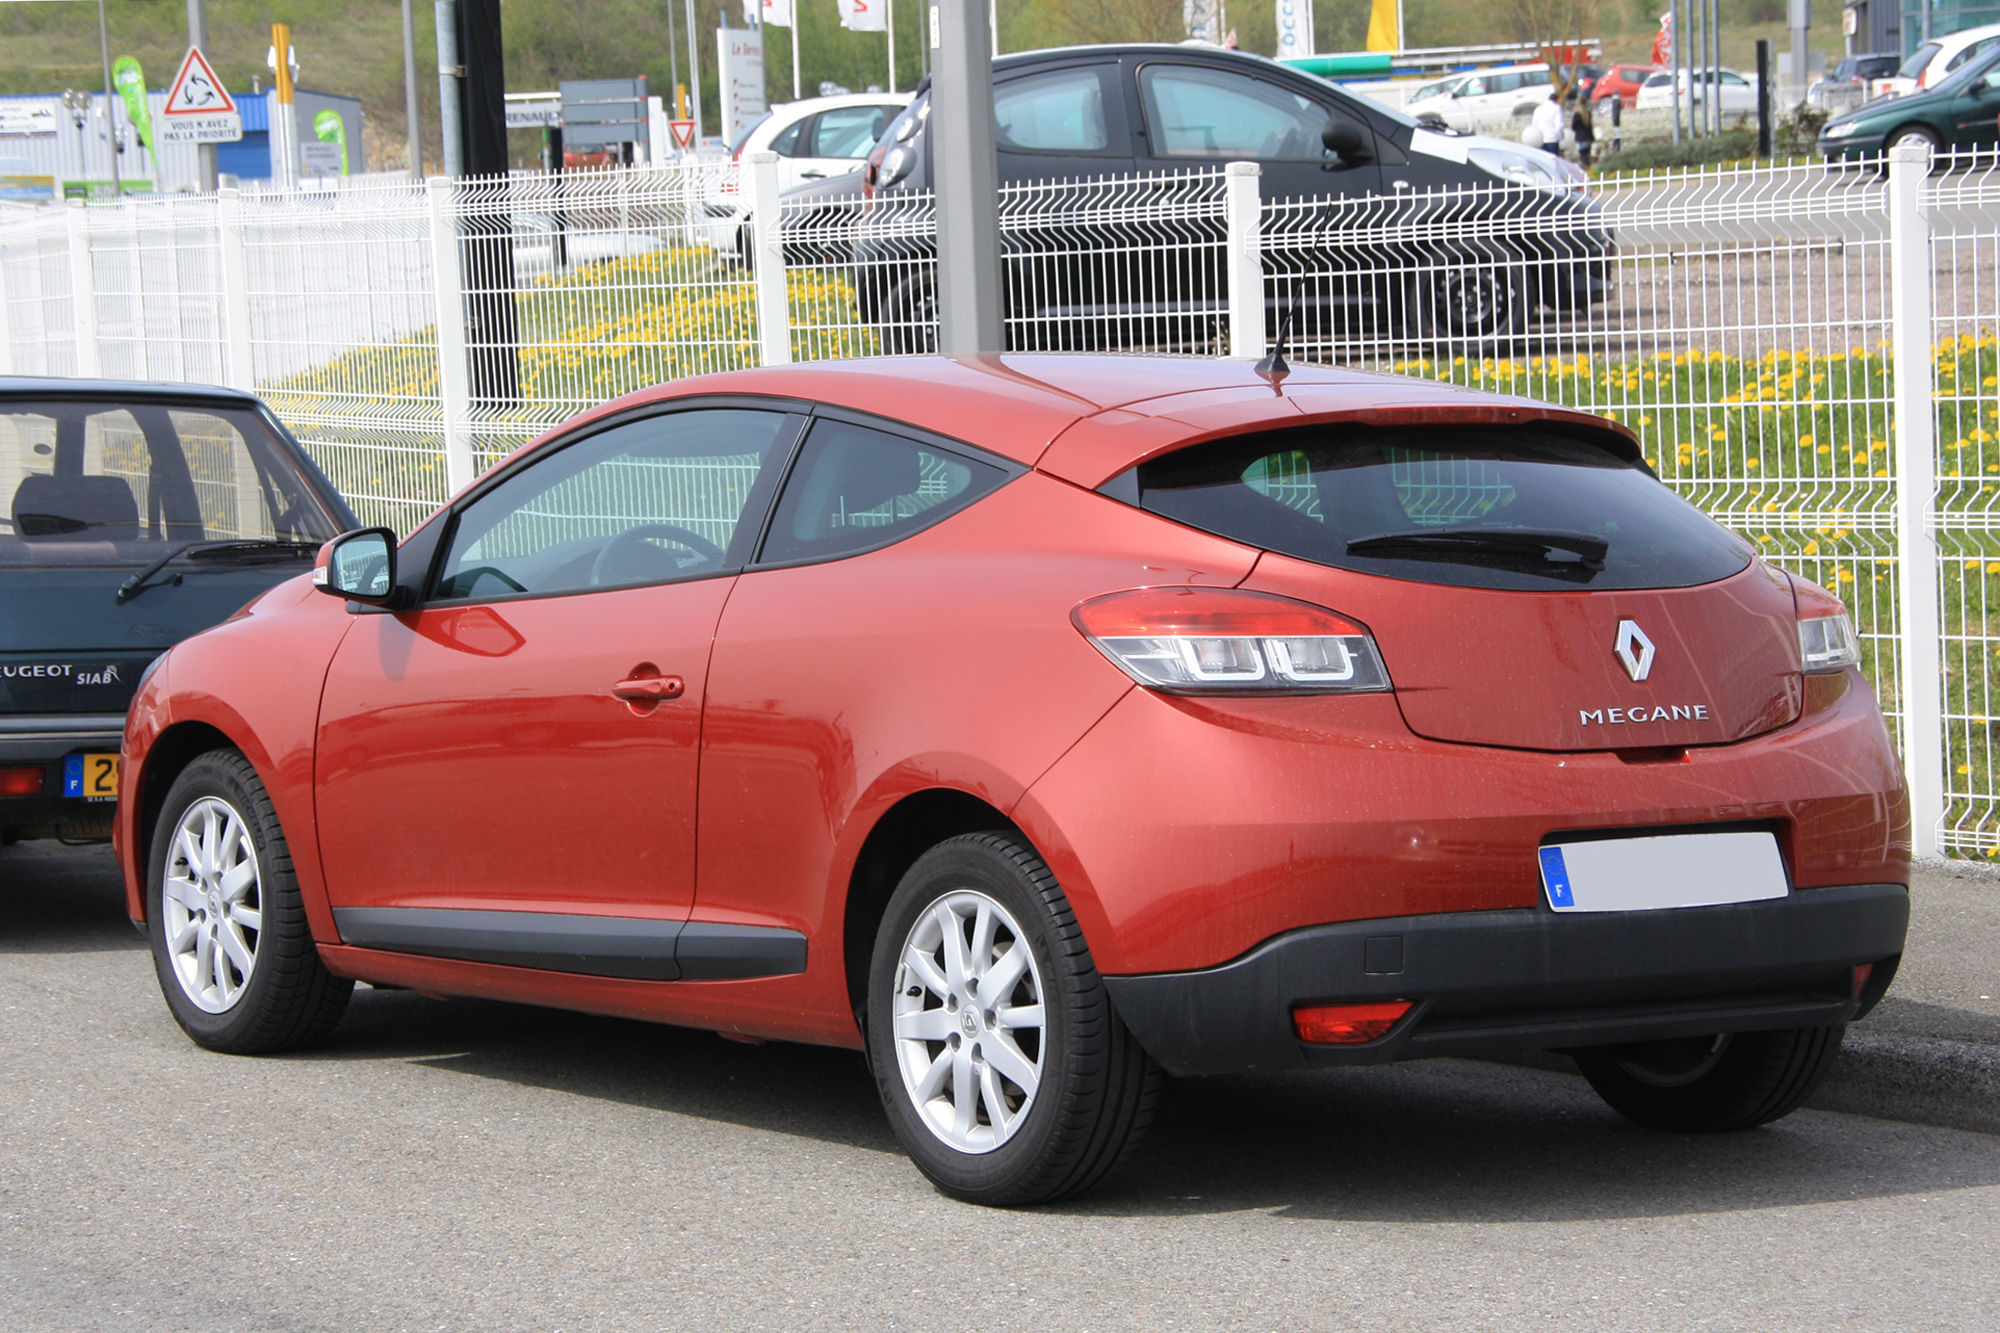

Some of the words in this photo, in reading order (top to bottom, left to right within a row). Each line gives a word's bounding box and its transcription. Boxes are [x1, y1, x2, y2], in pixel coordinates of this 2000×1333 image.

[1282, 0, 1295, 46] OCC
[171, 121, 194, 130] VOUS
[164, 132, 180, 141] PAS
[184, 132, 194, 140] LA
[198, 127, 238, 139] PRIORITÉ
[76, 672, 113, 685] SIAB
[1579, 704, 1710, 726] MEGANE
[70, 779, 79, 790] F
[1554, 883, 1563, 898] F
